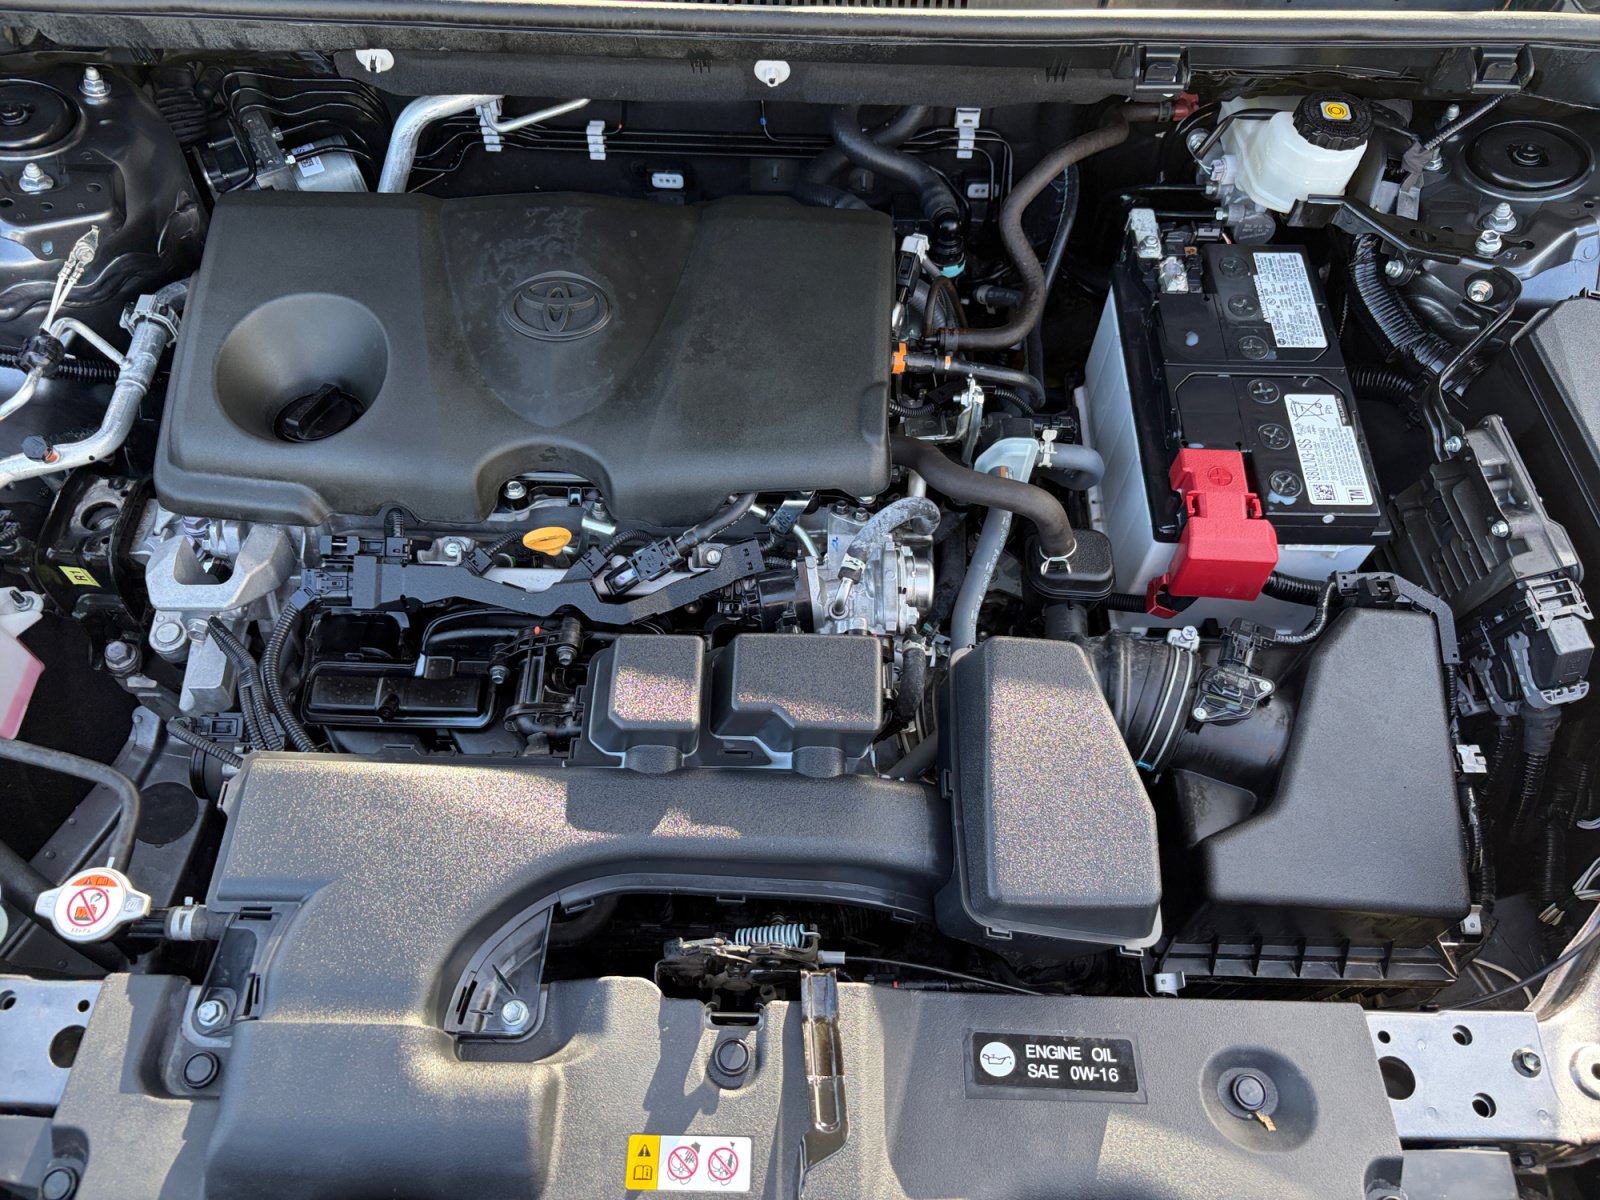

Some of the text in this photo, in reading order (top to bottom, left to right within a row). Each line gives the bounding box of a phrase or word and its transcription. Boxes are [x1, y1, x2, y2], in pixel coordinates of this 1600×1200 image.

[1348, 489, 1365, 501] TM
[1025, 1043, 1117, 1063] ENGINE OIL
[1027, 1063, 1119, 1083] SAE 0W-16
